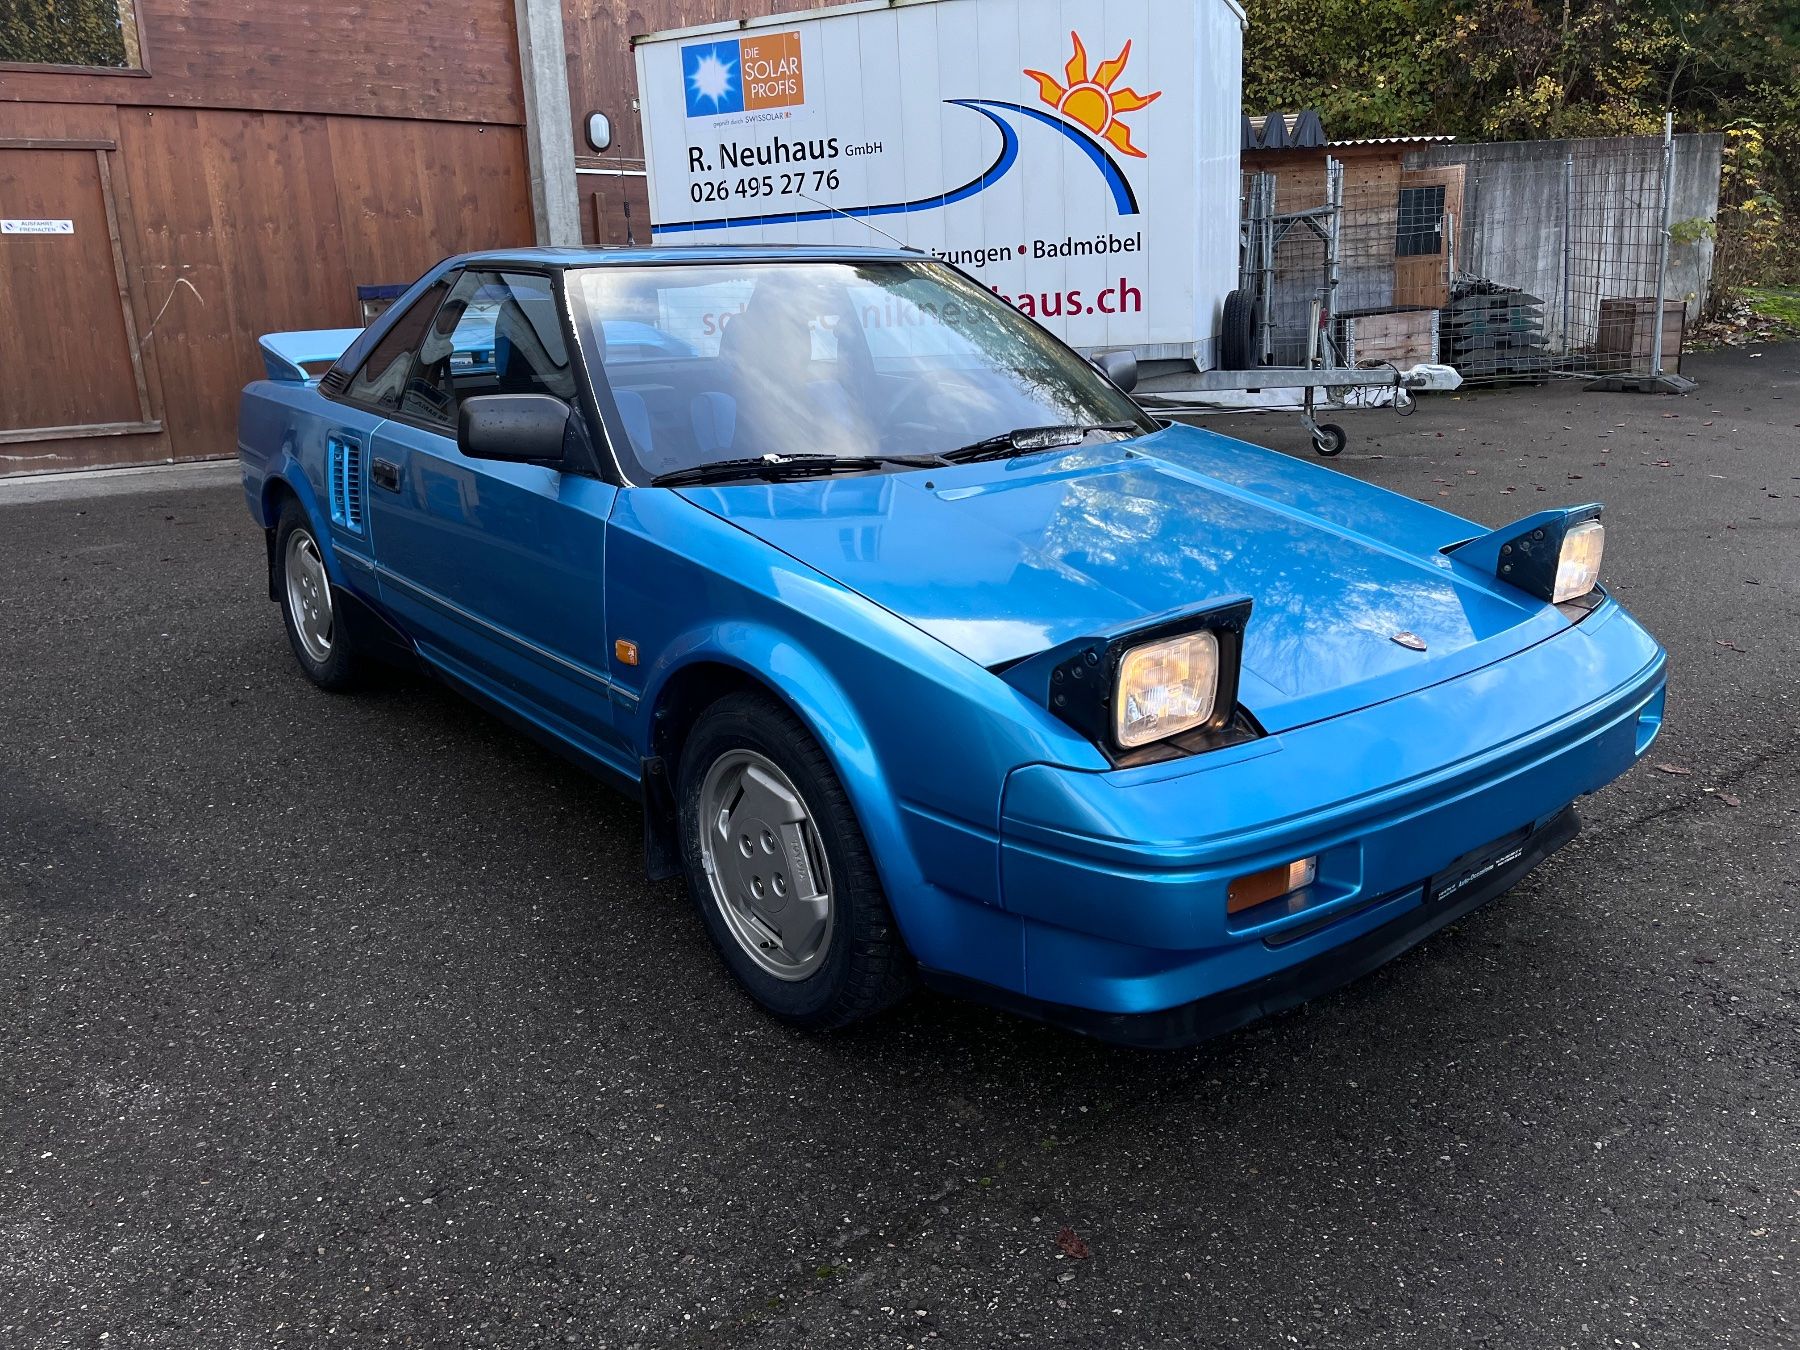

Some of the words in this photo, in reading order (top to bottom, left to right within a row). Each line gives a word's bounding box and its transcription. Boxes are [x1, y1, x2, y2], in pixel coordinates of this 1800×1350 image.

[744, 46, 760, 59] DIE
[744, 57, 800, 81] SOLAR
[751, 79, 797, 99] PROFIS
[745, 112, 784, 124] SWISSOLAR
[688, 146, 712, 173] R.
[719, 136, 839, 170] Neuhaus
[845, 141, 883, 157] GmbH
[690, 180, 729, 203] 026
[735, 176, 774, 199] 495
[780, 172, 806, 195] 27
[812, 168, 840, 192] 76
[1033, 231, 1141, 258] Badmöbel
[790, 840, 807, 881] TOYOTA
